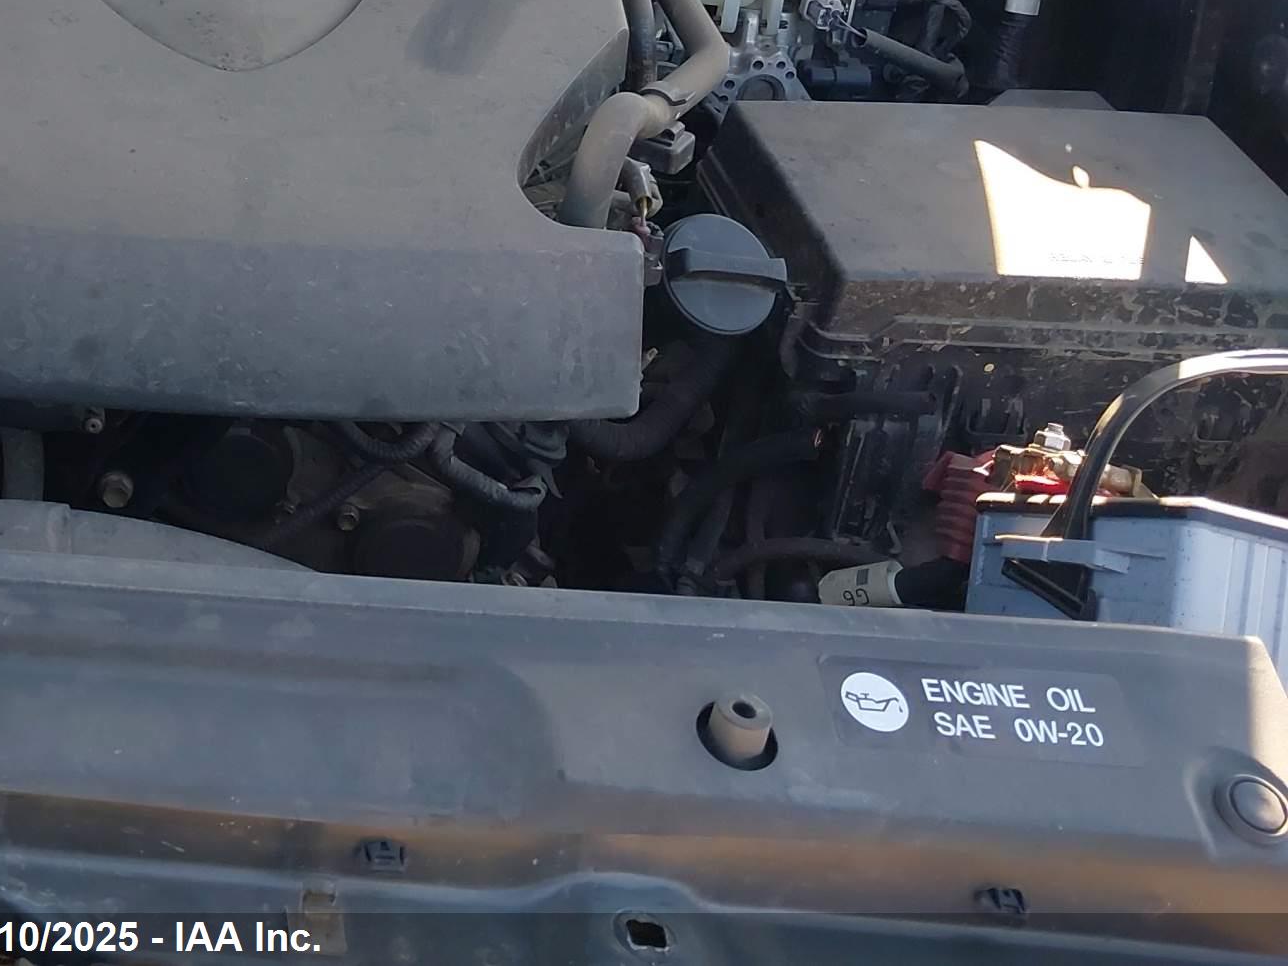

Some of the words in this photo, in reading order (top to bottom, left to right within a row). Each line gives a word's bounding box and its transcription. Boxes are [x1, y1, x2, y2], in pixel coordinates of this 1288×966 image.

[920, 678, 1031, 709] ENGINE
[1046, 687, 1096, 713] OIL
[933, 711, 997, 739] SAE
[1014, 718, 1105, 747] 0W-20
